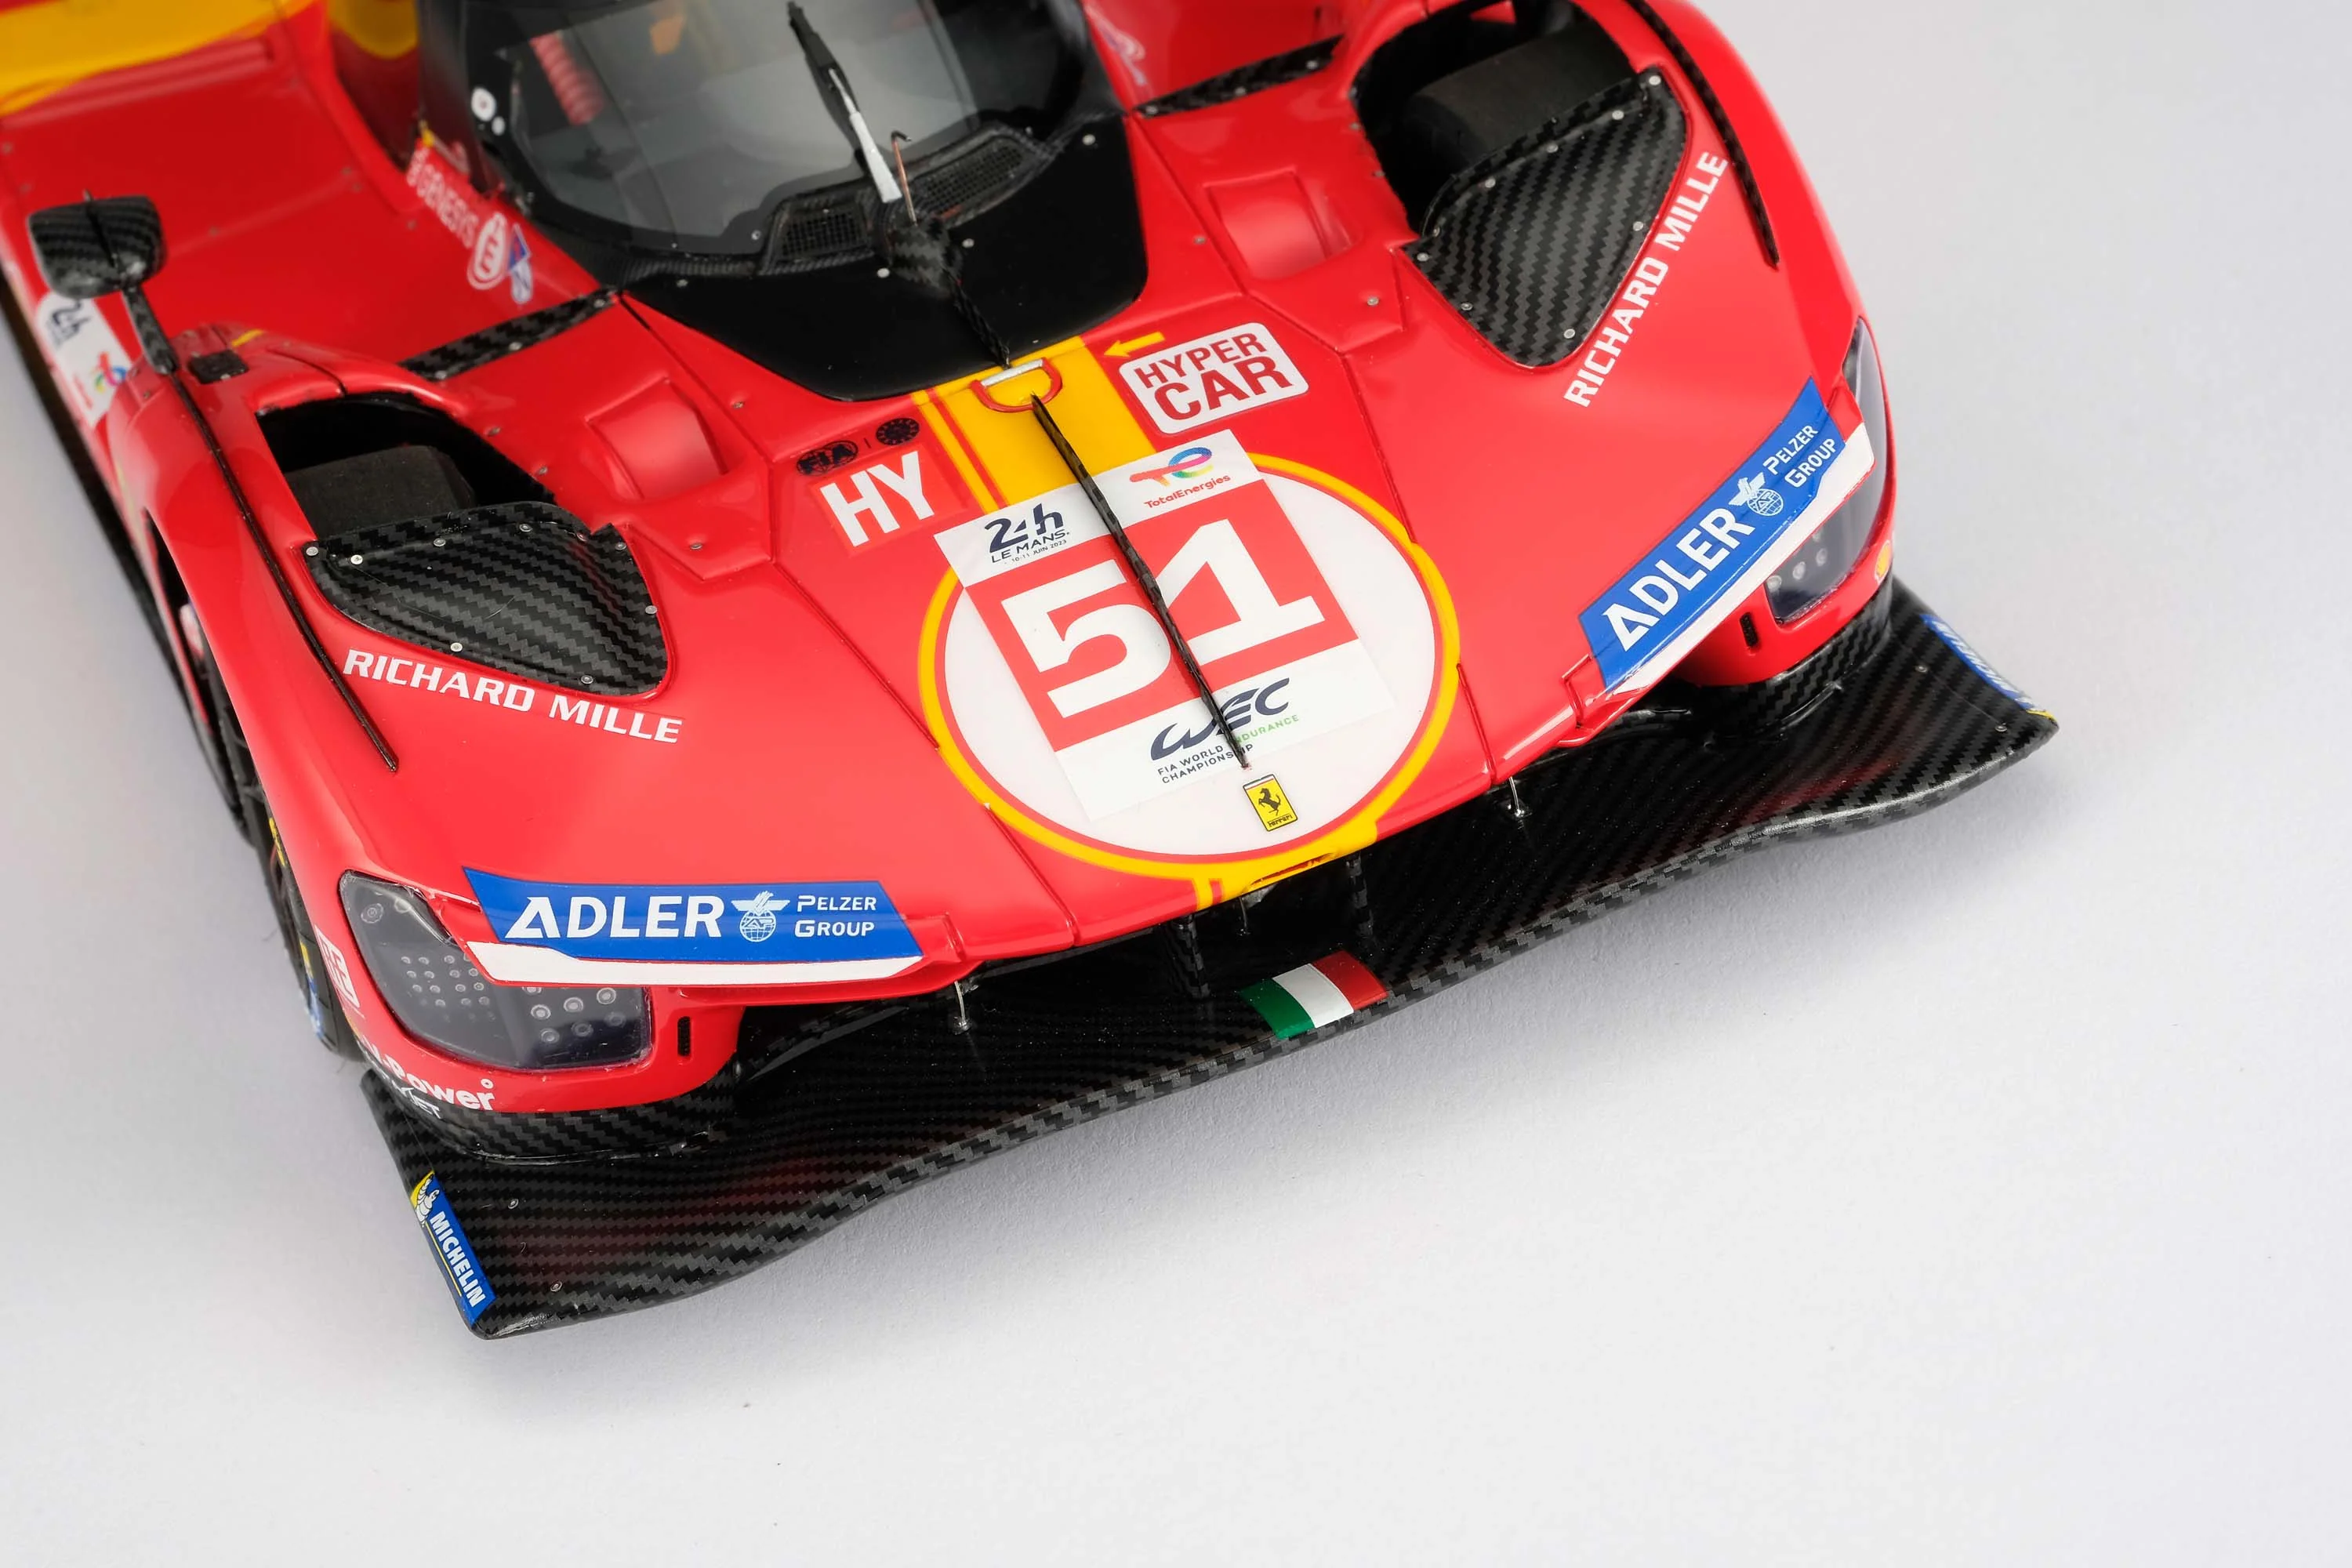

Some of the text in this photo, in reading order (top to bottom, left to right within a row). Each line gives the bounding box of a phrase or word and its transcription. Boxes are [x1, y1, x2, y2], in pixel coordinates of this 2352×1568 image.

[1563, 151, 1728, 407] RICHARD MILLE
[1134, 332, 1267, 389] HYPER
[1154, 356, 1293, 421] CAR
[1763, 425, 1819, 475] PELZER
[1784, 438, 1836, 488] GROUP
[819, 451, 935, 547] HY
[1144, 475, 1231, 508] TotalEnergies
[991, 549, 1011, 563] LE
[1033, 546, 1049, 555] JUIN
[1051, 539, 1067, 549] 2023
[1602, 508, 1756, 652] ADLER
[1000, 518, 1326, 719] 51
[343, 649, 683, 743] RICHARD MILLE
[1150, 677, 1290, 761] WEC
[1157, 714, 1300, 776] FIA WORLD NDURANCE
[1161, 743, 1254, 785] CHAMPIONSIP
[504, 895, 724, 939] ADLER
[793, 919, 875, 938] GROUP
[797, 895, 877, 913] PELZER
[429, 1210, 486, 1308] MICHELIN
